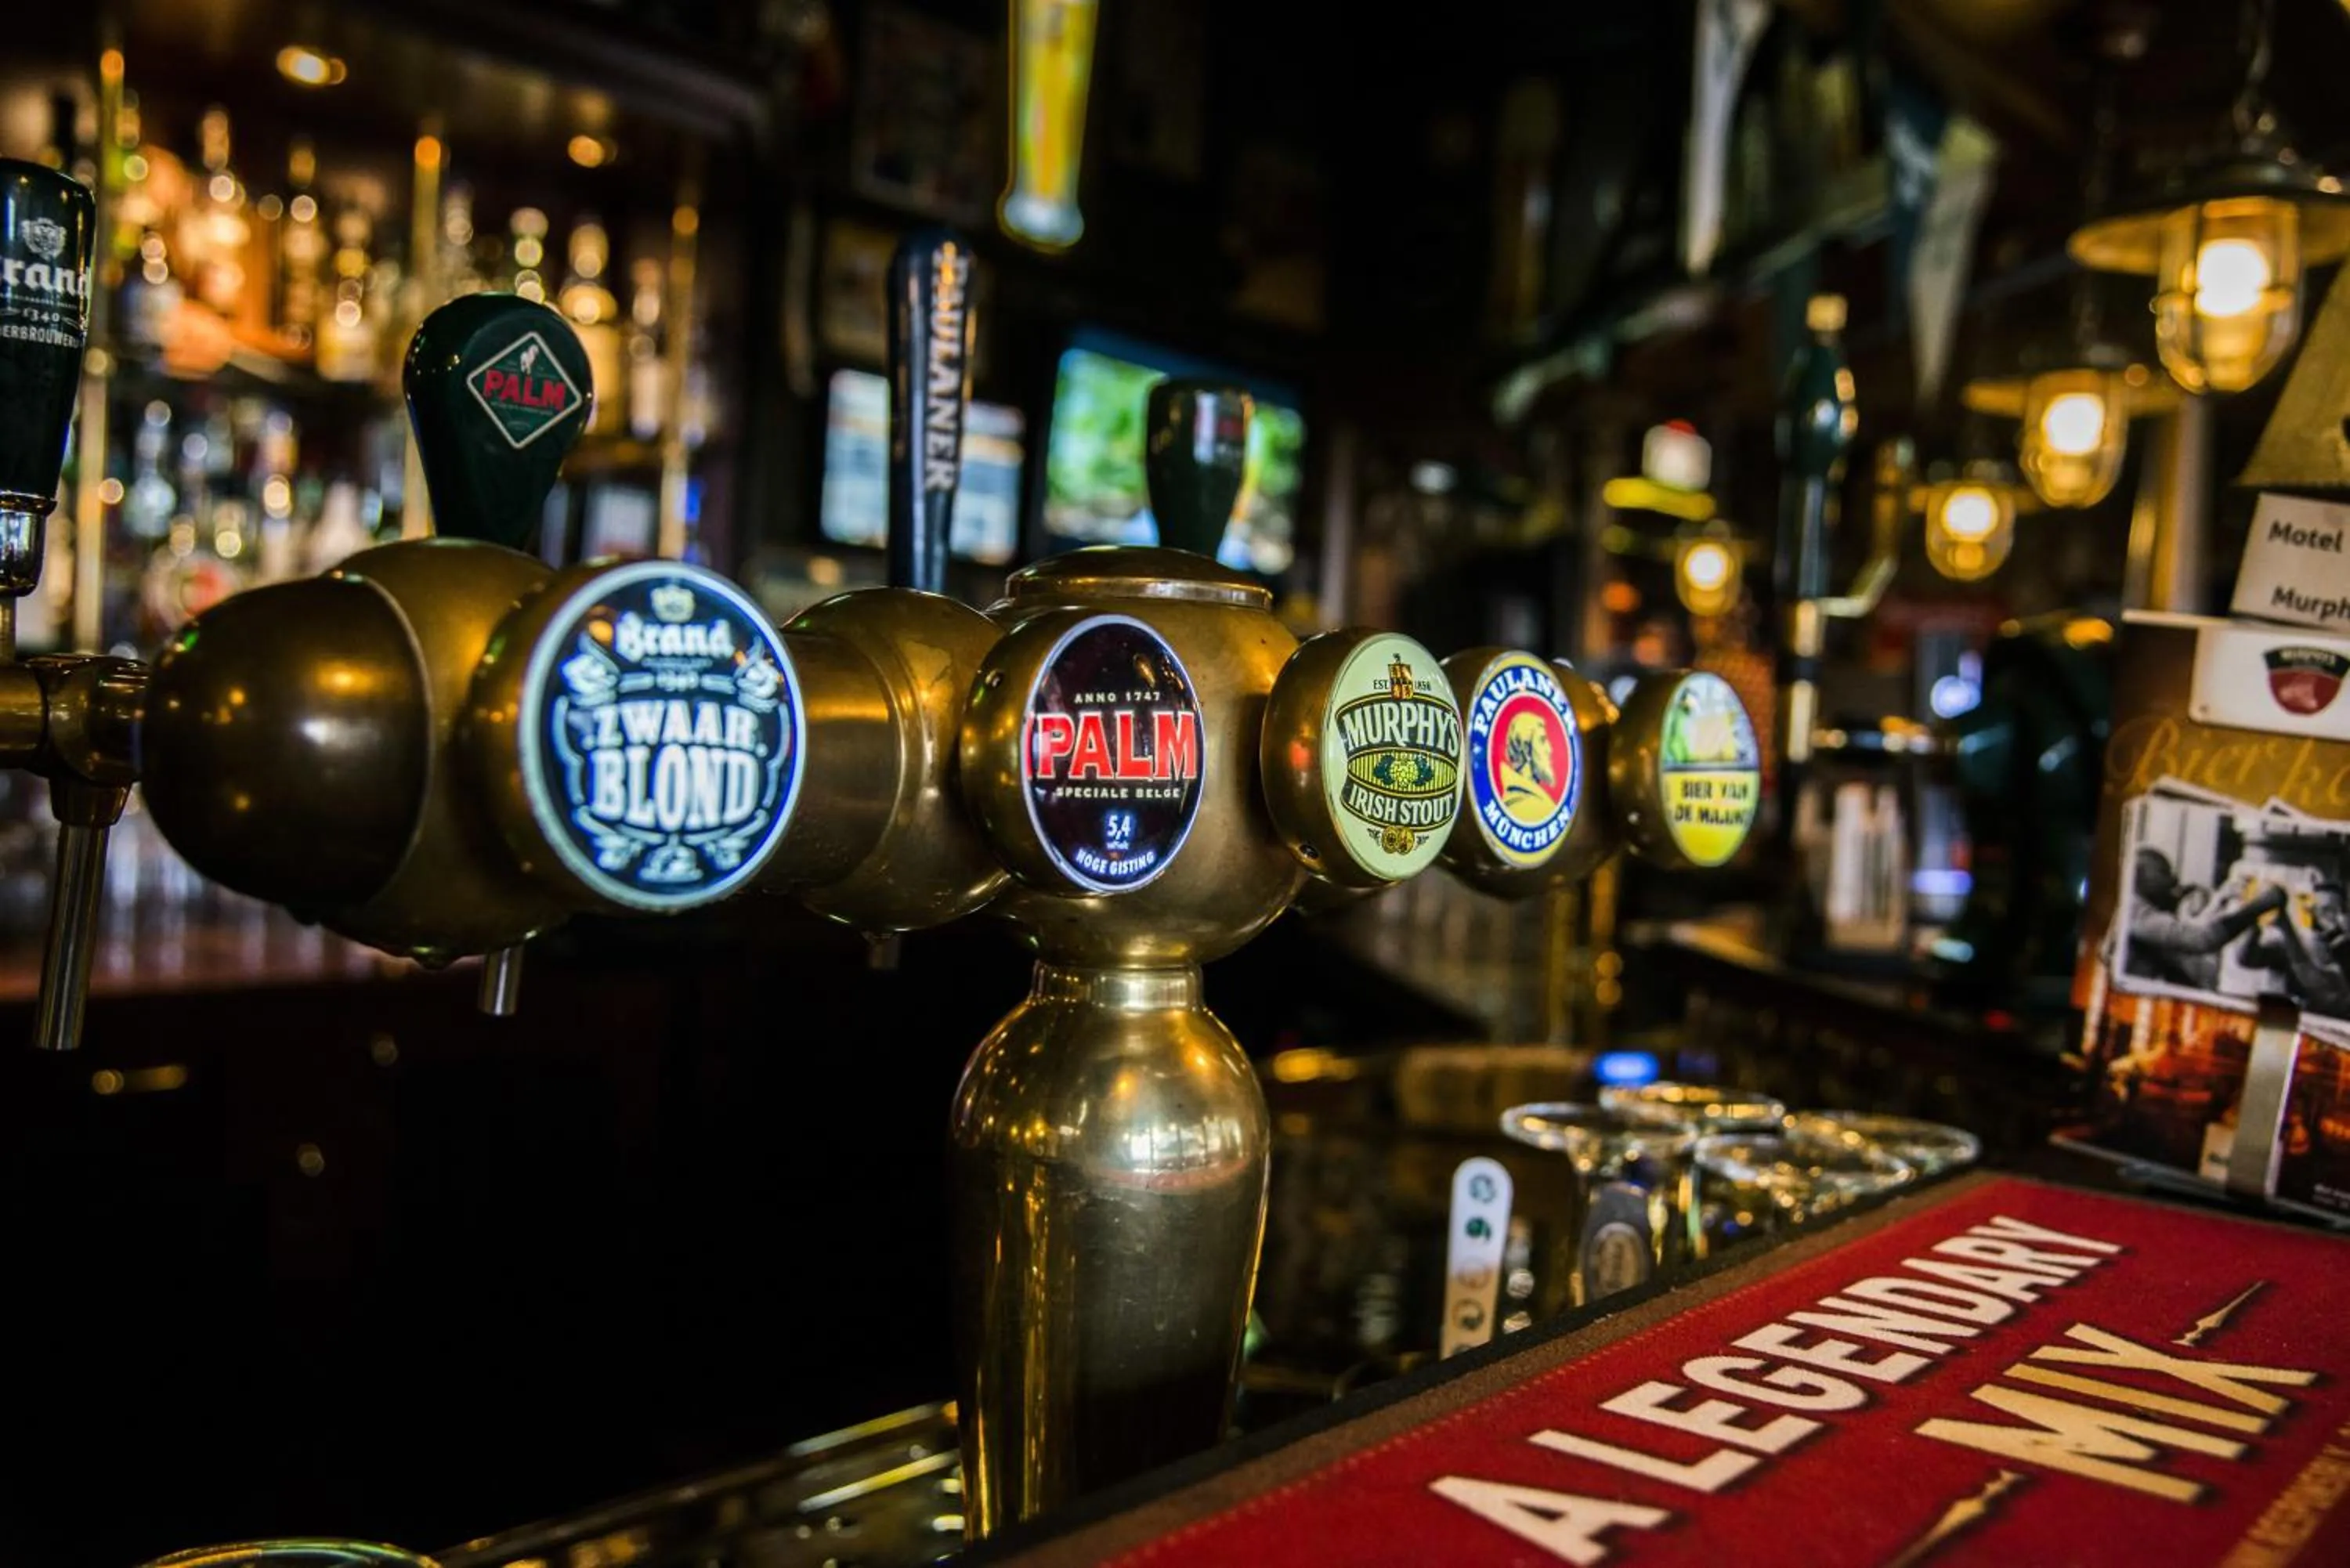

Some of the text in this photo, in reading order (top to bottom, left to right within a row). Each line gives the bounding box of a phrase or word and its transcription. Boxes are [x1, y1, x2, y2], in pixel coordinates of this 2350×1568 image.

[483, 369, 566, 412] PALM
[2269, 519, 2344, 554] Motel
[616, 610, 735, 662] Brand
[1074, 691, 1160, 703] ANNO 1747
[1473, 667, 1576, 736] PAULANER
[593, 699, 757, 753] ZWAAR
[1036, 710, 1198, 781] PALM
[591, 743, 759, 832] BLOND
[1056, 786, 1180, 799] SPECIALE BELGE
[1348, 784, 1455, 826] IRISH STOUT
[1682, 781, 1712, 799] BIER
[1107, 815, 1130, 840] 5,4
[1076, 847, 1155, 875] HOGE GISTING
[1428, 1216, 2124, 1566] A LEGENDARY
[1913, 1322, 2319, 1504] MIX
